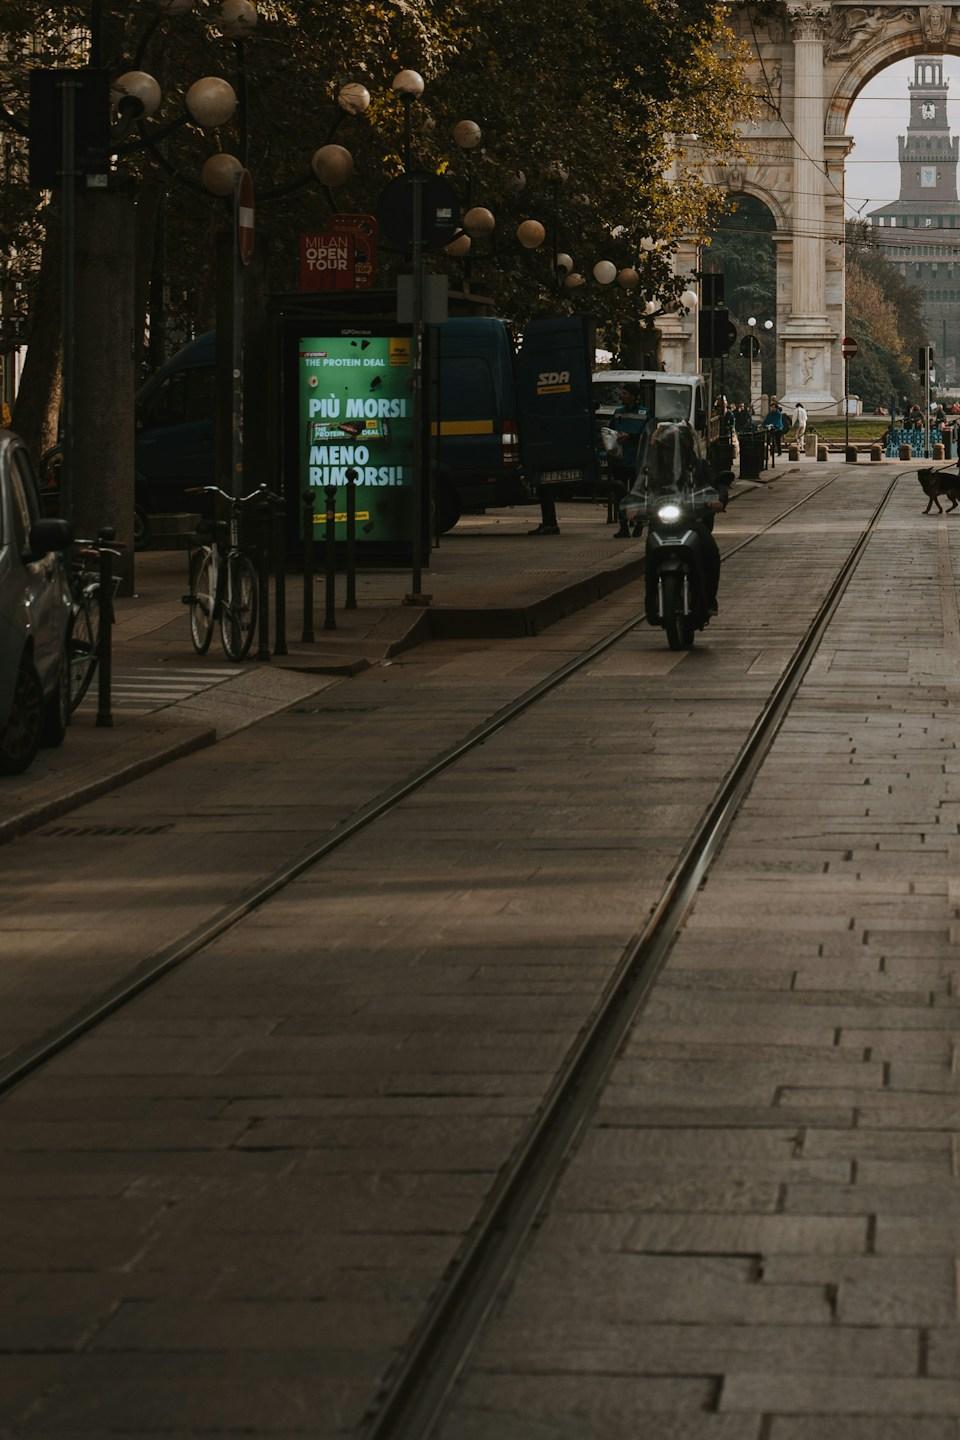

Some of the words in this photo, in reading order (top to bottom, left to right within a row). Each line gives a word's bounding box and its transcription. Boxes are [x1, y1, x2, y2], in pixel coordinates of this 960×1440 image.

[305, 236, 348, 249] MILAN
[305, 248, 348, 260] OPEN
[306, 259, 348, 271] TOUR
[305, 359, 321, 367] THE
[323, 359, 361, 367] PROTEIN
[363, 359, 385, 367] DEAL
[536, 370, 570, 386] SDA
[309, 393, 340, 418] PIÙ
[345, 398, 406, 418] MORSI
[309, 445, 369, 465] MENO
